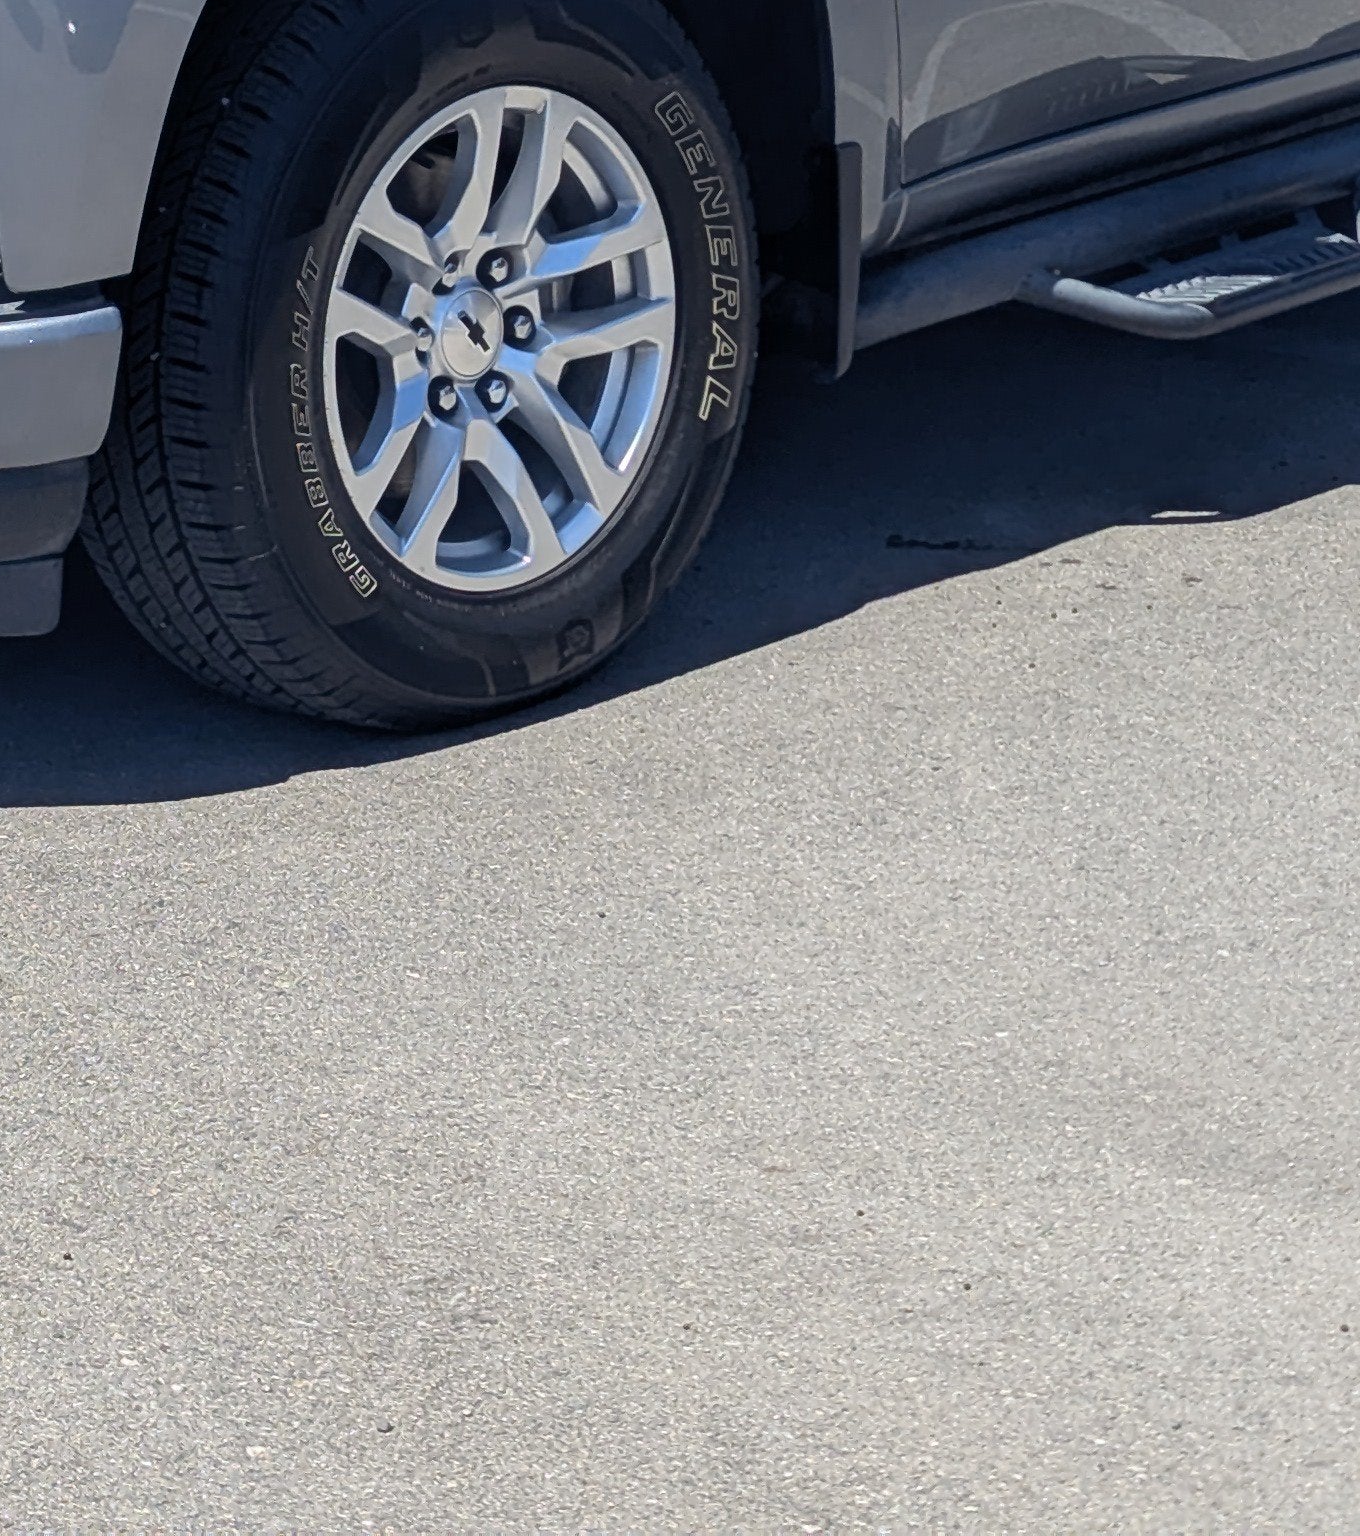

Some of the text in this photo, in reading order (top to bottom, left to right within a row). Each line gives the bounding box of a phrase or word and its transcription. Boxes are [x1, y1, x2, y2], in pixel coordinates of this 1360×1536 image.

[290, 245, 378, 598] GRABBER H/T
[654, 90, 741, 422] GENERAL
